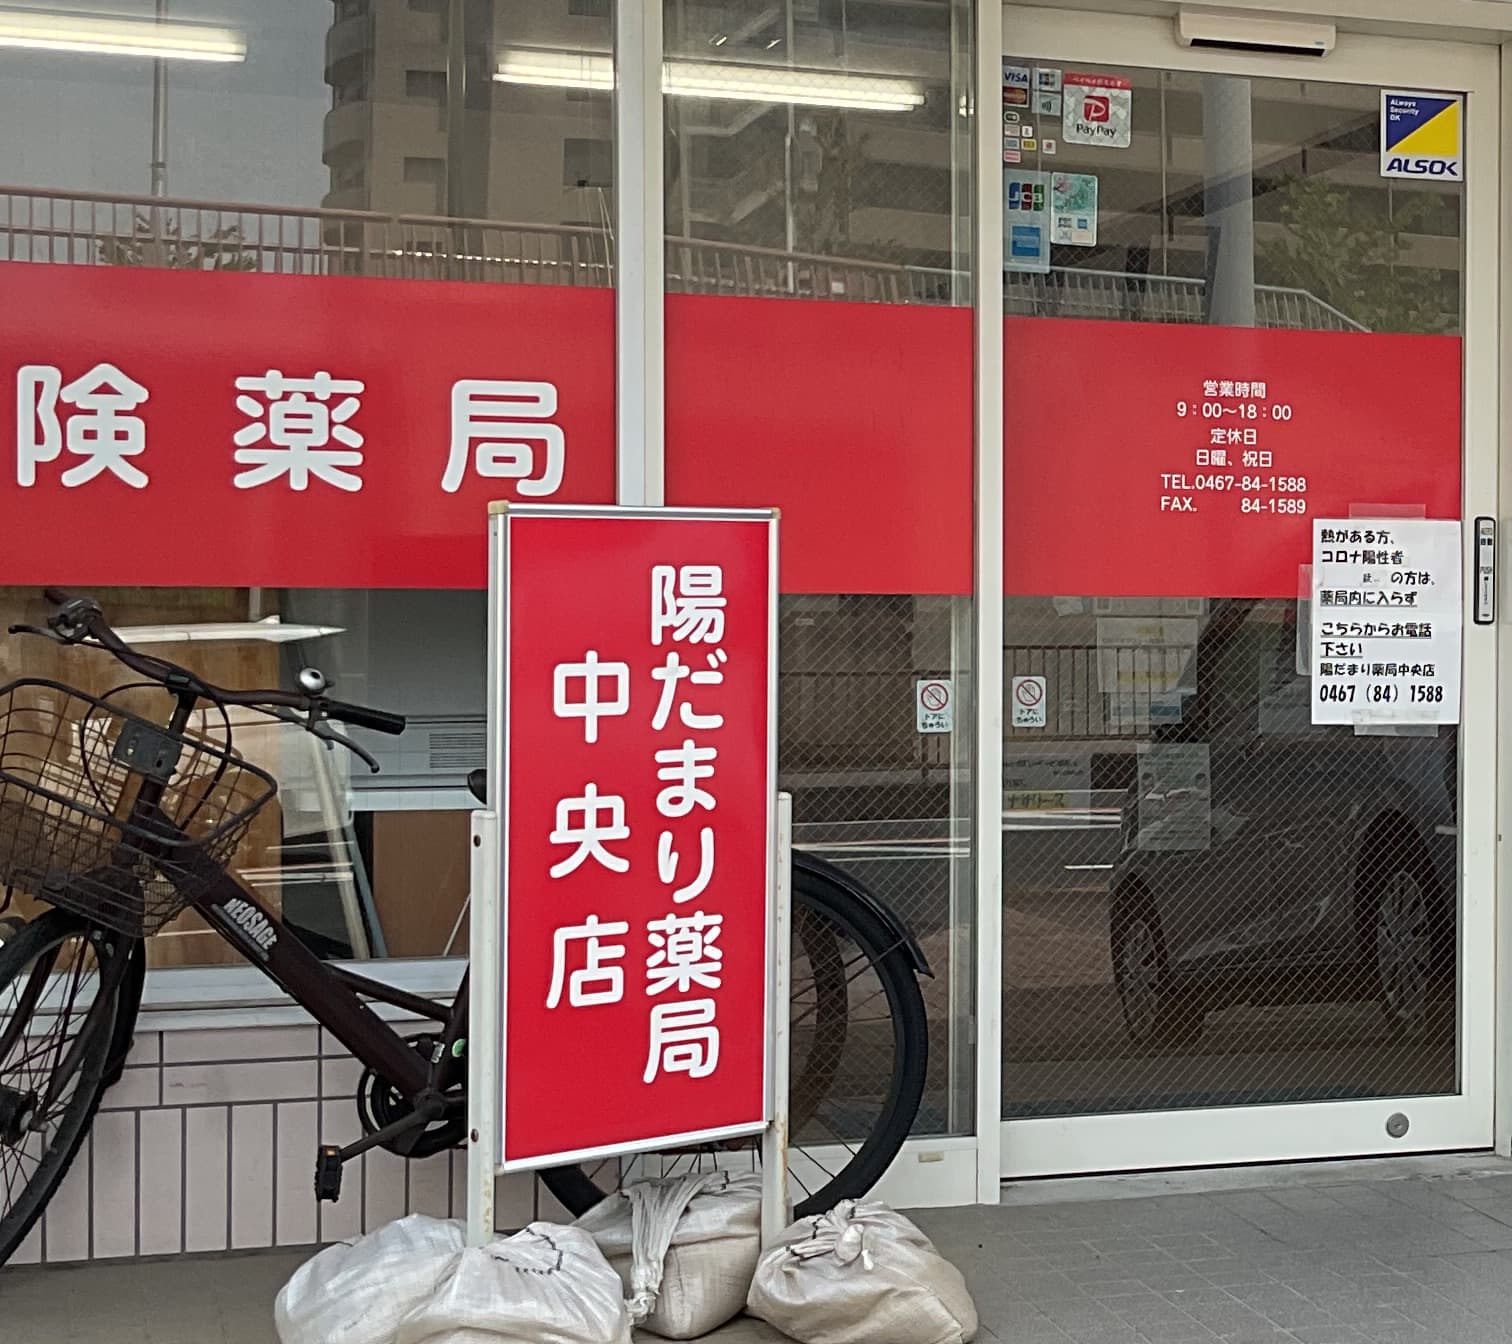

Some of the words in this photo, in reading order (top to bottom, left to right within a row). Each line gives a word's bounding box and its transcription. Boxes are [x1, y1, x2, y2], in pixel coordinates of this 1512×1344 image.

[1004, 72, 1028, 83] VISA
[1076, 123, 1118, 138] PayPay
[1386, 157, 1458, 176] ALSOK
[1203, 380, 1267, 399] 営業時間
[1210, 428, 1257, 445] 定休日
[1196, 449, 1273, 468] 日曜、祝日
[1160, 496, 1198, 513] FAX.
[1241, 498, 1307, 514] 84-1589
[1320, 529, 1395, 545] 熱がある方、
[1321, 550, 1404, 565] コロナ陽性者
[1320, 590, 1418, 605] 薬局内に入らず
[1321, 622, 1432, 638] こちらからお電話
[1320, 642, 1363, 657] 下さい
[1320, 663, 1436, 677] 陽だまり薬局中央店
[545, 649, 631, 1011] 中央店
[643, 563, 728, 1084] 陽だまり薬局
[223, 897, 278, 951] NEOSAGE
